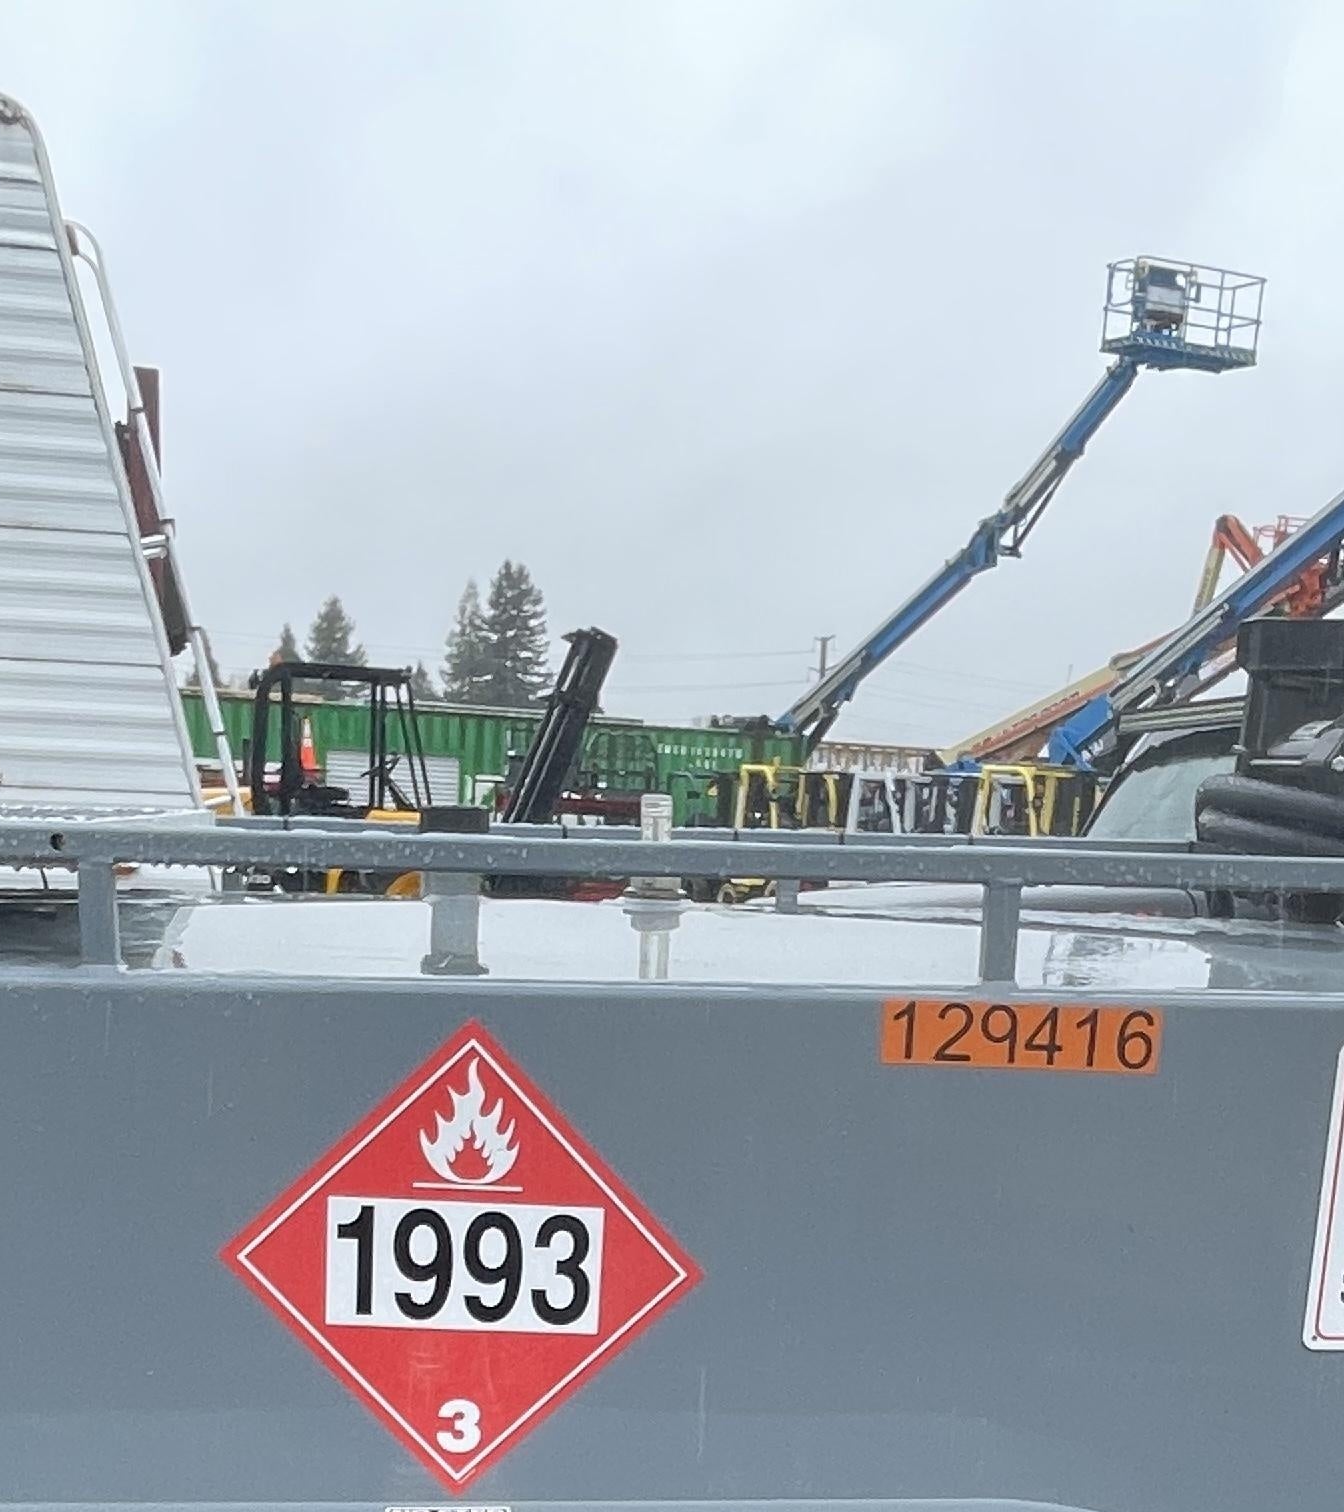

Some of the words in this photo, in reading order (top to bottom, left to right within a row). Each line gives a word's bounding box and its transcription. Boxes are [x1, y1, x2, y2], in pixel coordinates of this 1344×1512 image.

[892, 1000, 1154, 1070] 129416
[336, 1204, 591, 1327] 1993
[436, 1399, 482, 1454] 3
